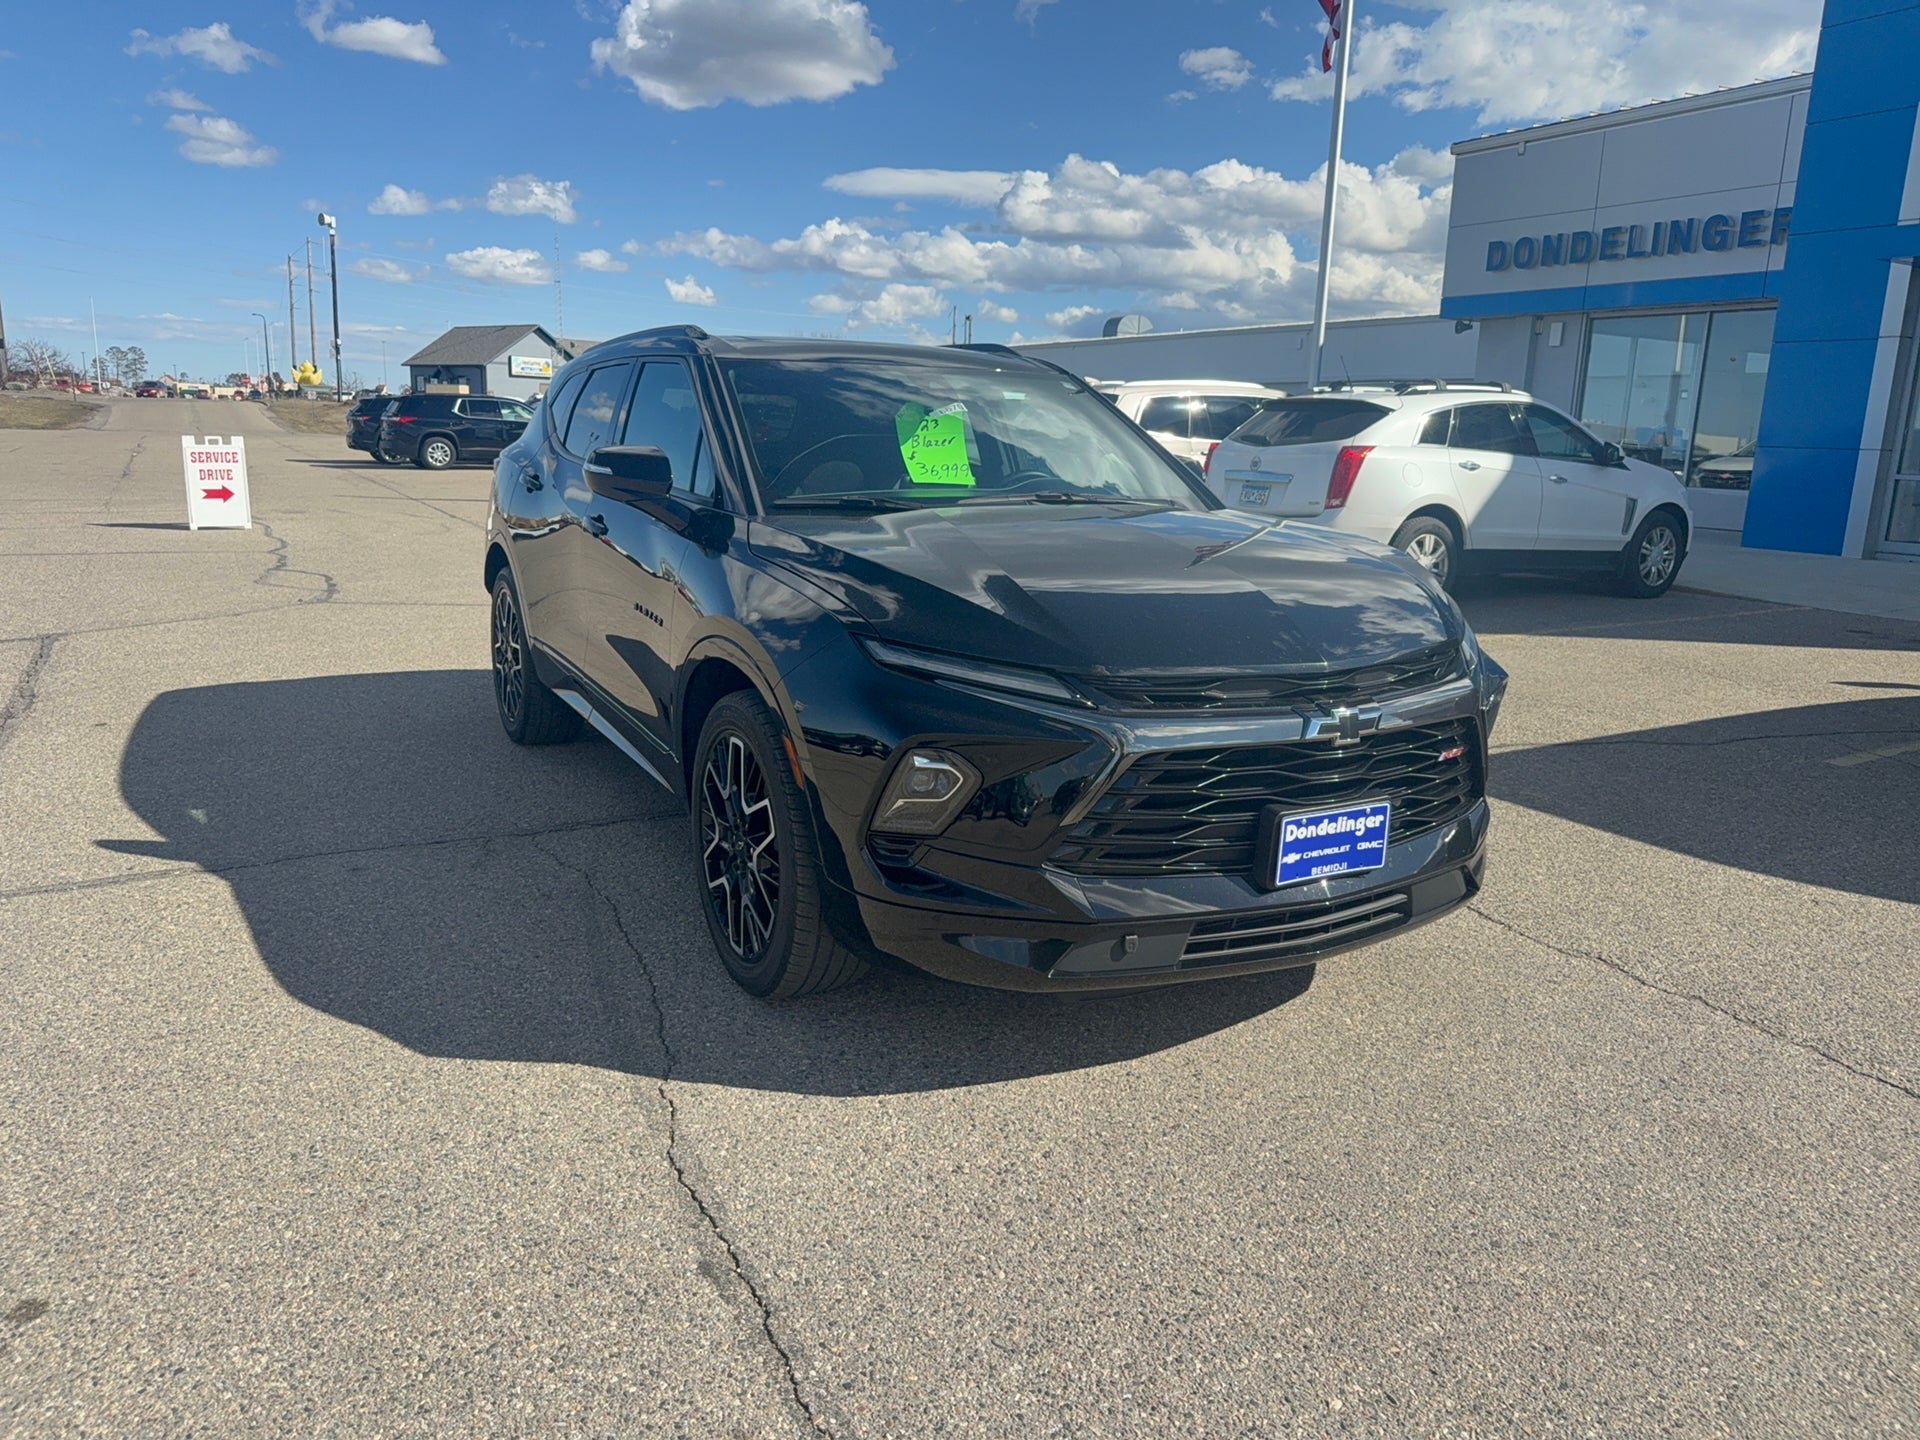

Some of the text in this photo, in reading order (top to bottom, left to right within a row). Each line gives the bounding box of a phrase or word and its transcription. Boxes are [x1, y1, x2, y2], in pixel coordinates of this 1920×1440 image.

[920, 418, 939, 432] 23
[911, 434, 956, 448] Blazer
[190, 451, 239, 464] SERVICE
[199, 468, 234, 481] DRIVE
[915, 462, 970, 480] 36,999
[1285, 814, 1385, 843] Dondelinger
[1303, 839, 1384, 859] CHEVROLET GMC
[1311, 862, 1348, 876] BEMIDJI
